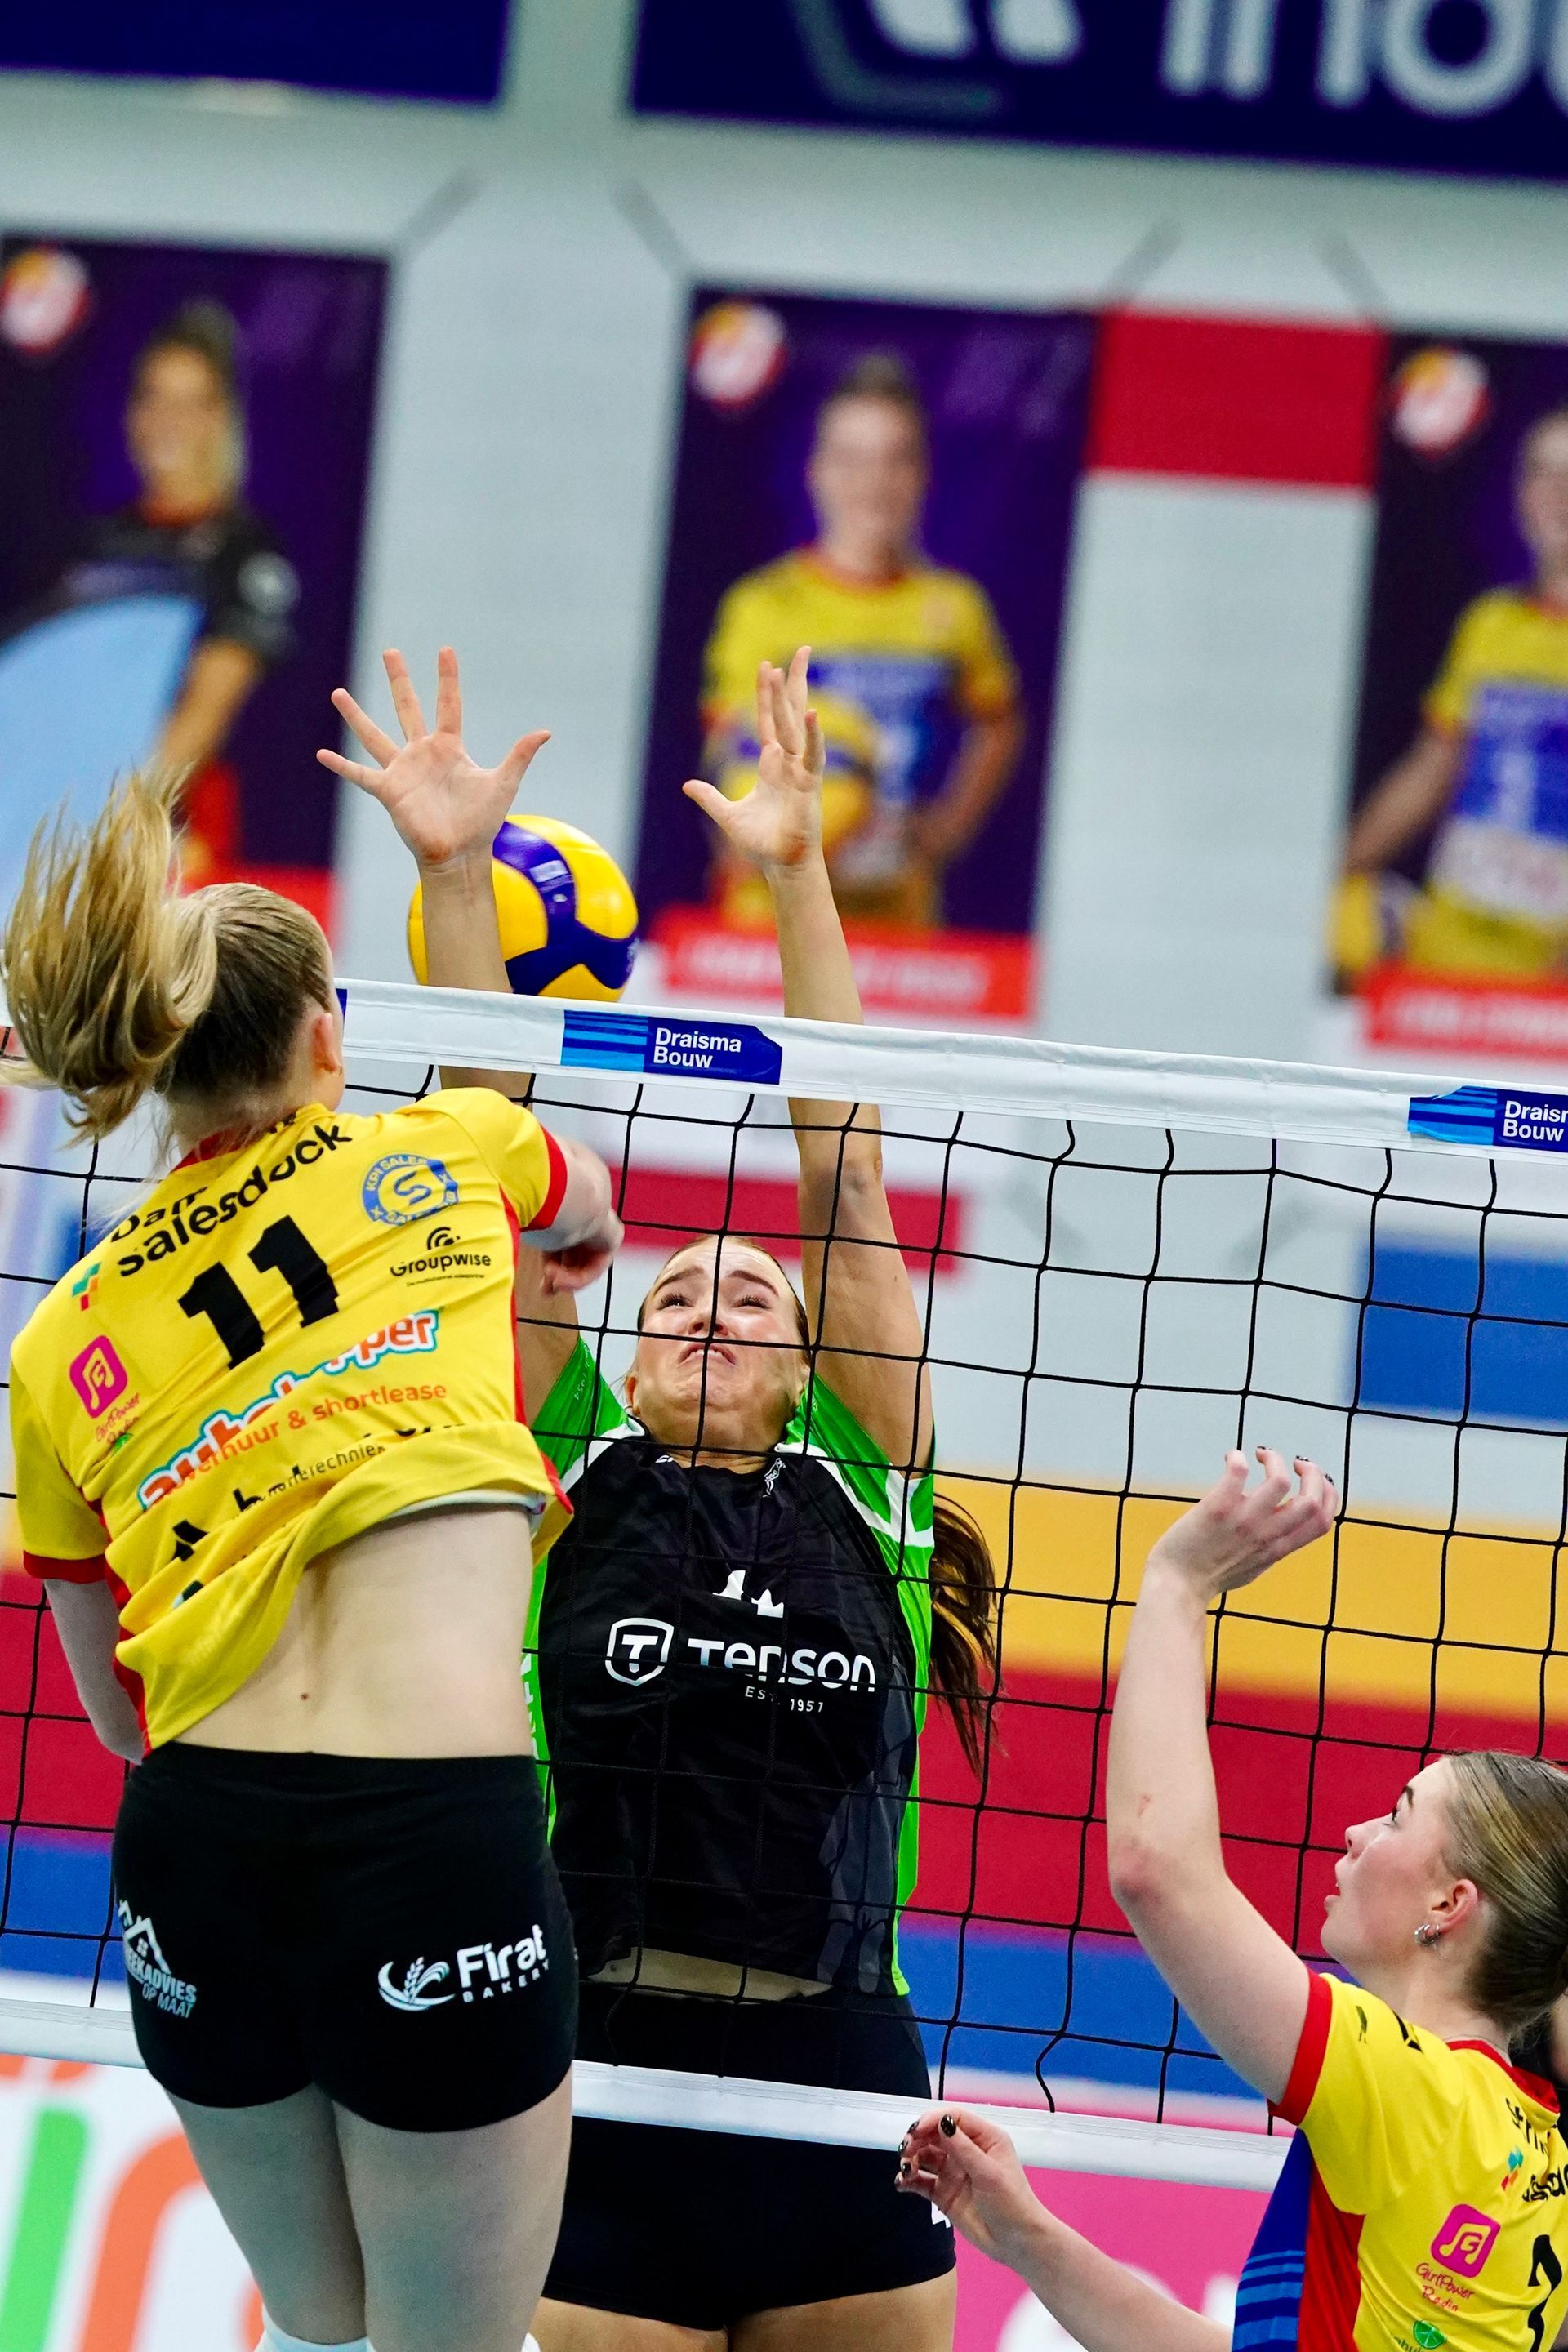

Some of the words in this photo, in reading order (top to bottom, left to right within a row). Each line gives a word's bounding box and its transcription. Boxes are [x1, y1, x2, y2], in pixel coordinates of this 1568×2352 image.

[653, 1045, 713, 1068] Bouw
[655, 1027, 742, 1053] Draisma
[1503, 1118, 1565, 1142] Bouw
[177, 1214, 339, 1371] 11
[287, 1410, 308, 1430] &
[315, 1383, 448, 1420] shortlease
[457, 1923, 547, 1989] Firat
[462, 1958, 550, 2003] BAKERY
[142, 1983, 158, 2001] OP
[157, 1992, 195, 2019] MAAT
[1415, 2262, 1476, 2300] GirlPower
